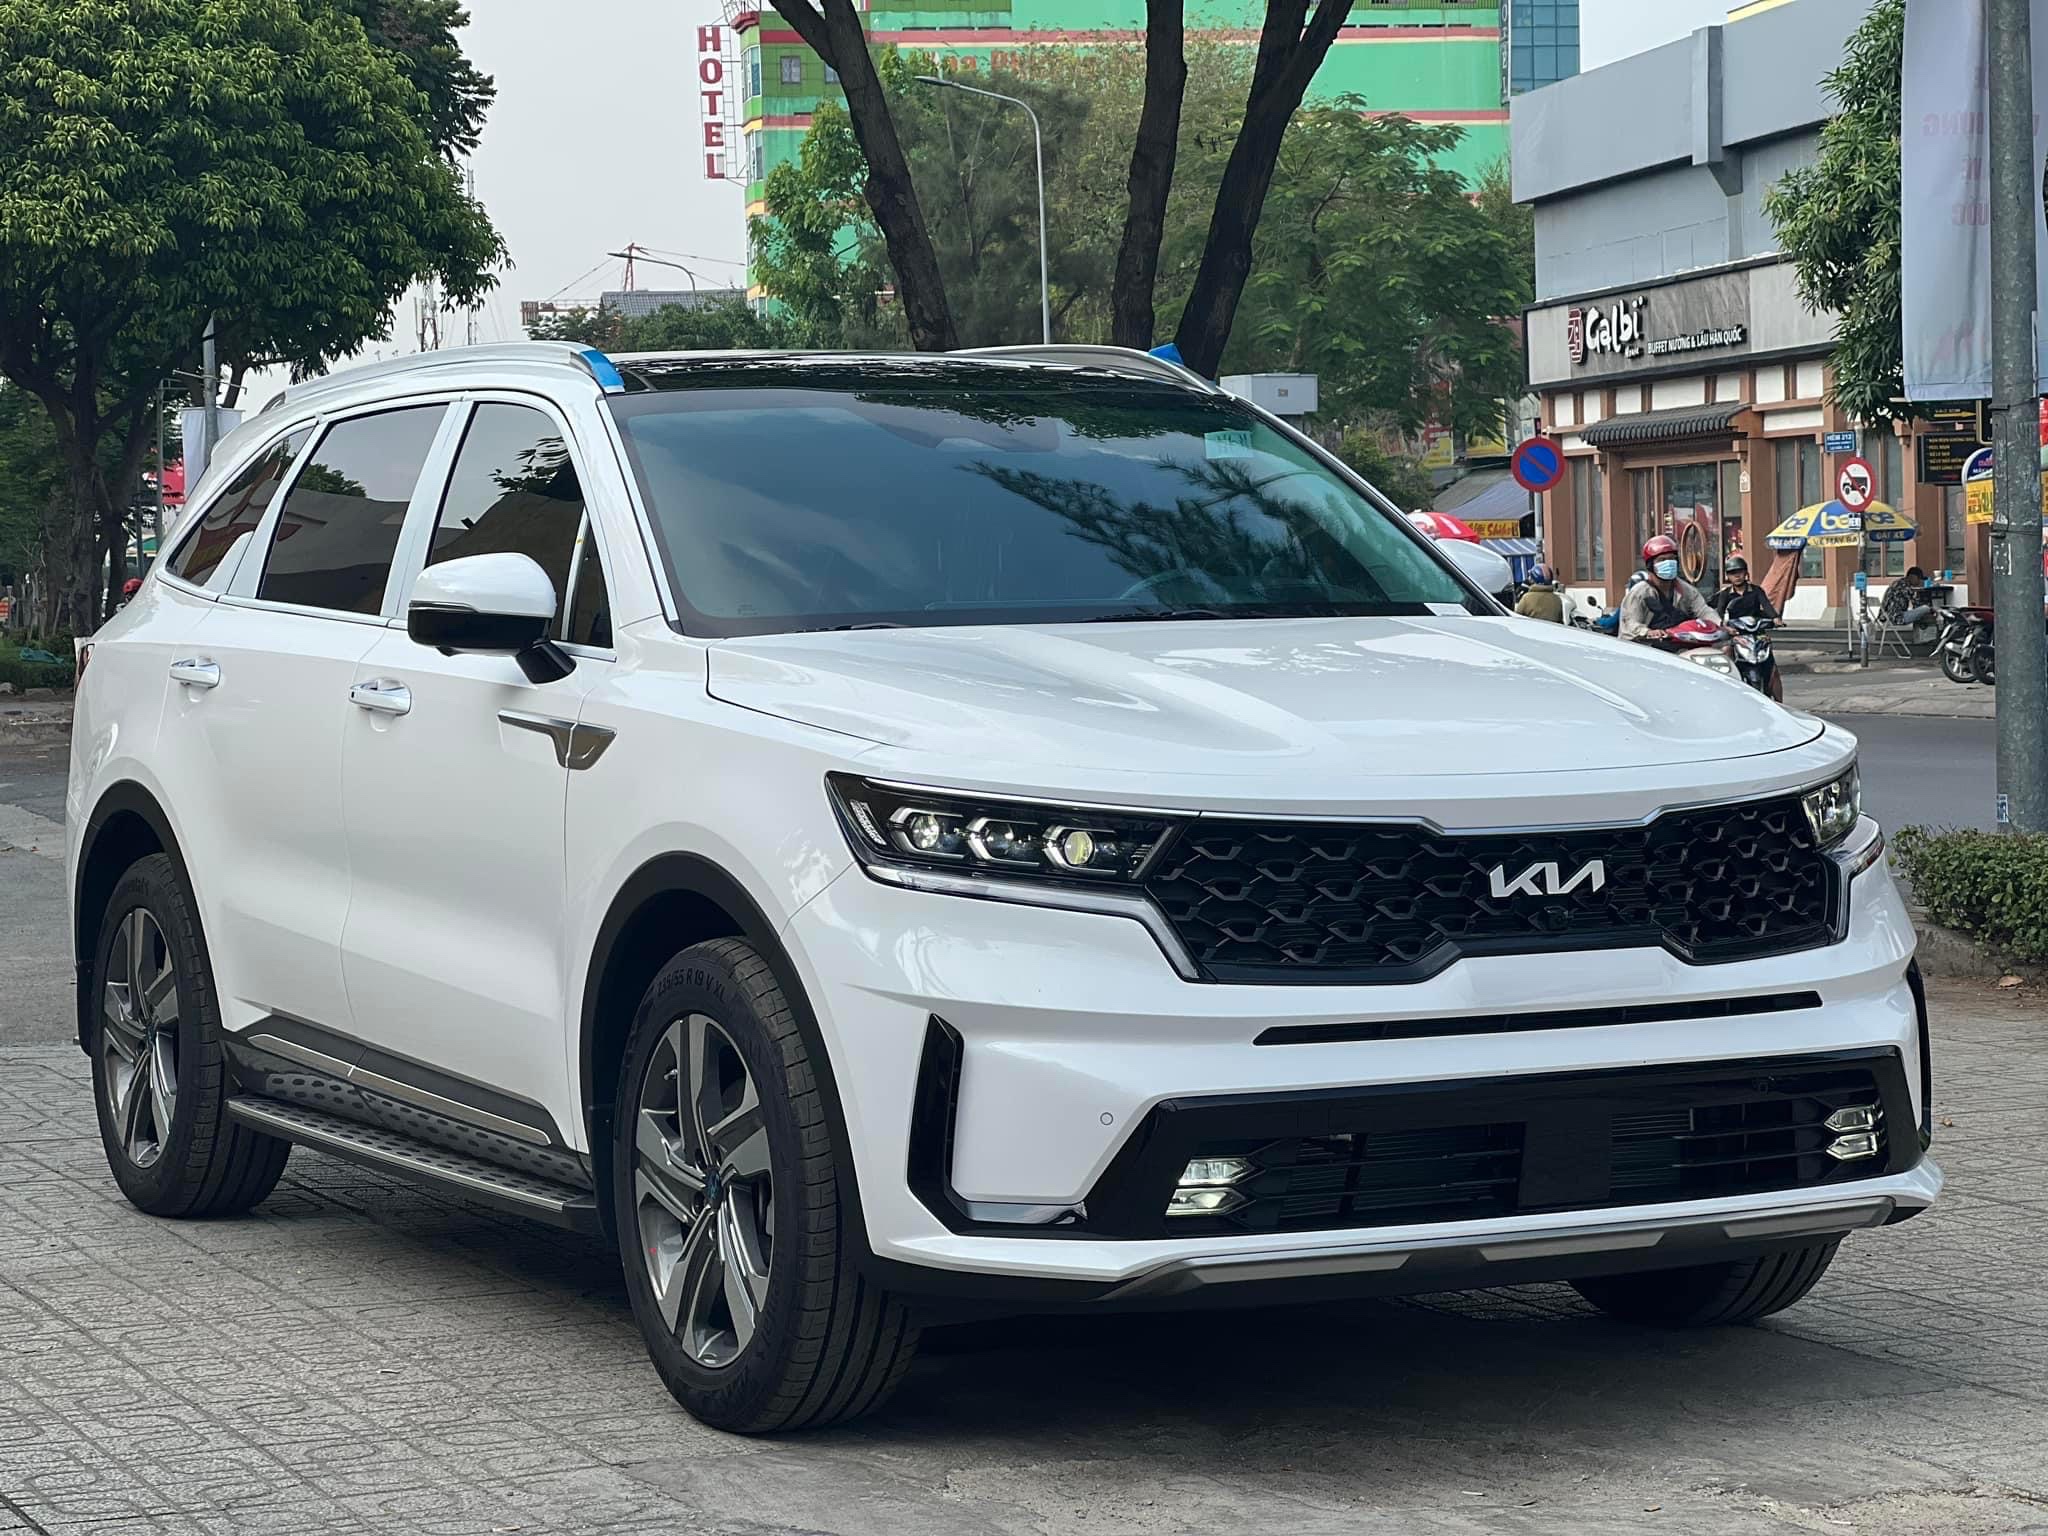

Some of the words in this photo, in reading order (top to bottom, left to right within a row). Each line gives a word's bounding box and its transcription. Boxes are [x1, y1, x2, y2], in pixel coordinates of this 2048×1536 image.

[698, 26, 725, 179] HOTEL
[1585, 296, 1644, 353] Galbi
[1647, 340, 1668, 354] BUFFET
[1489, 859, 1605, 898] KIA
